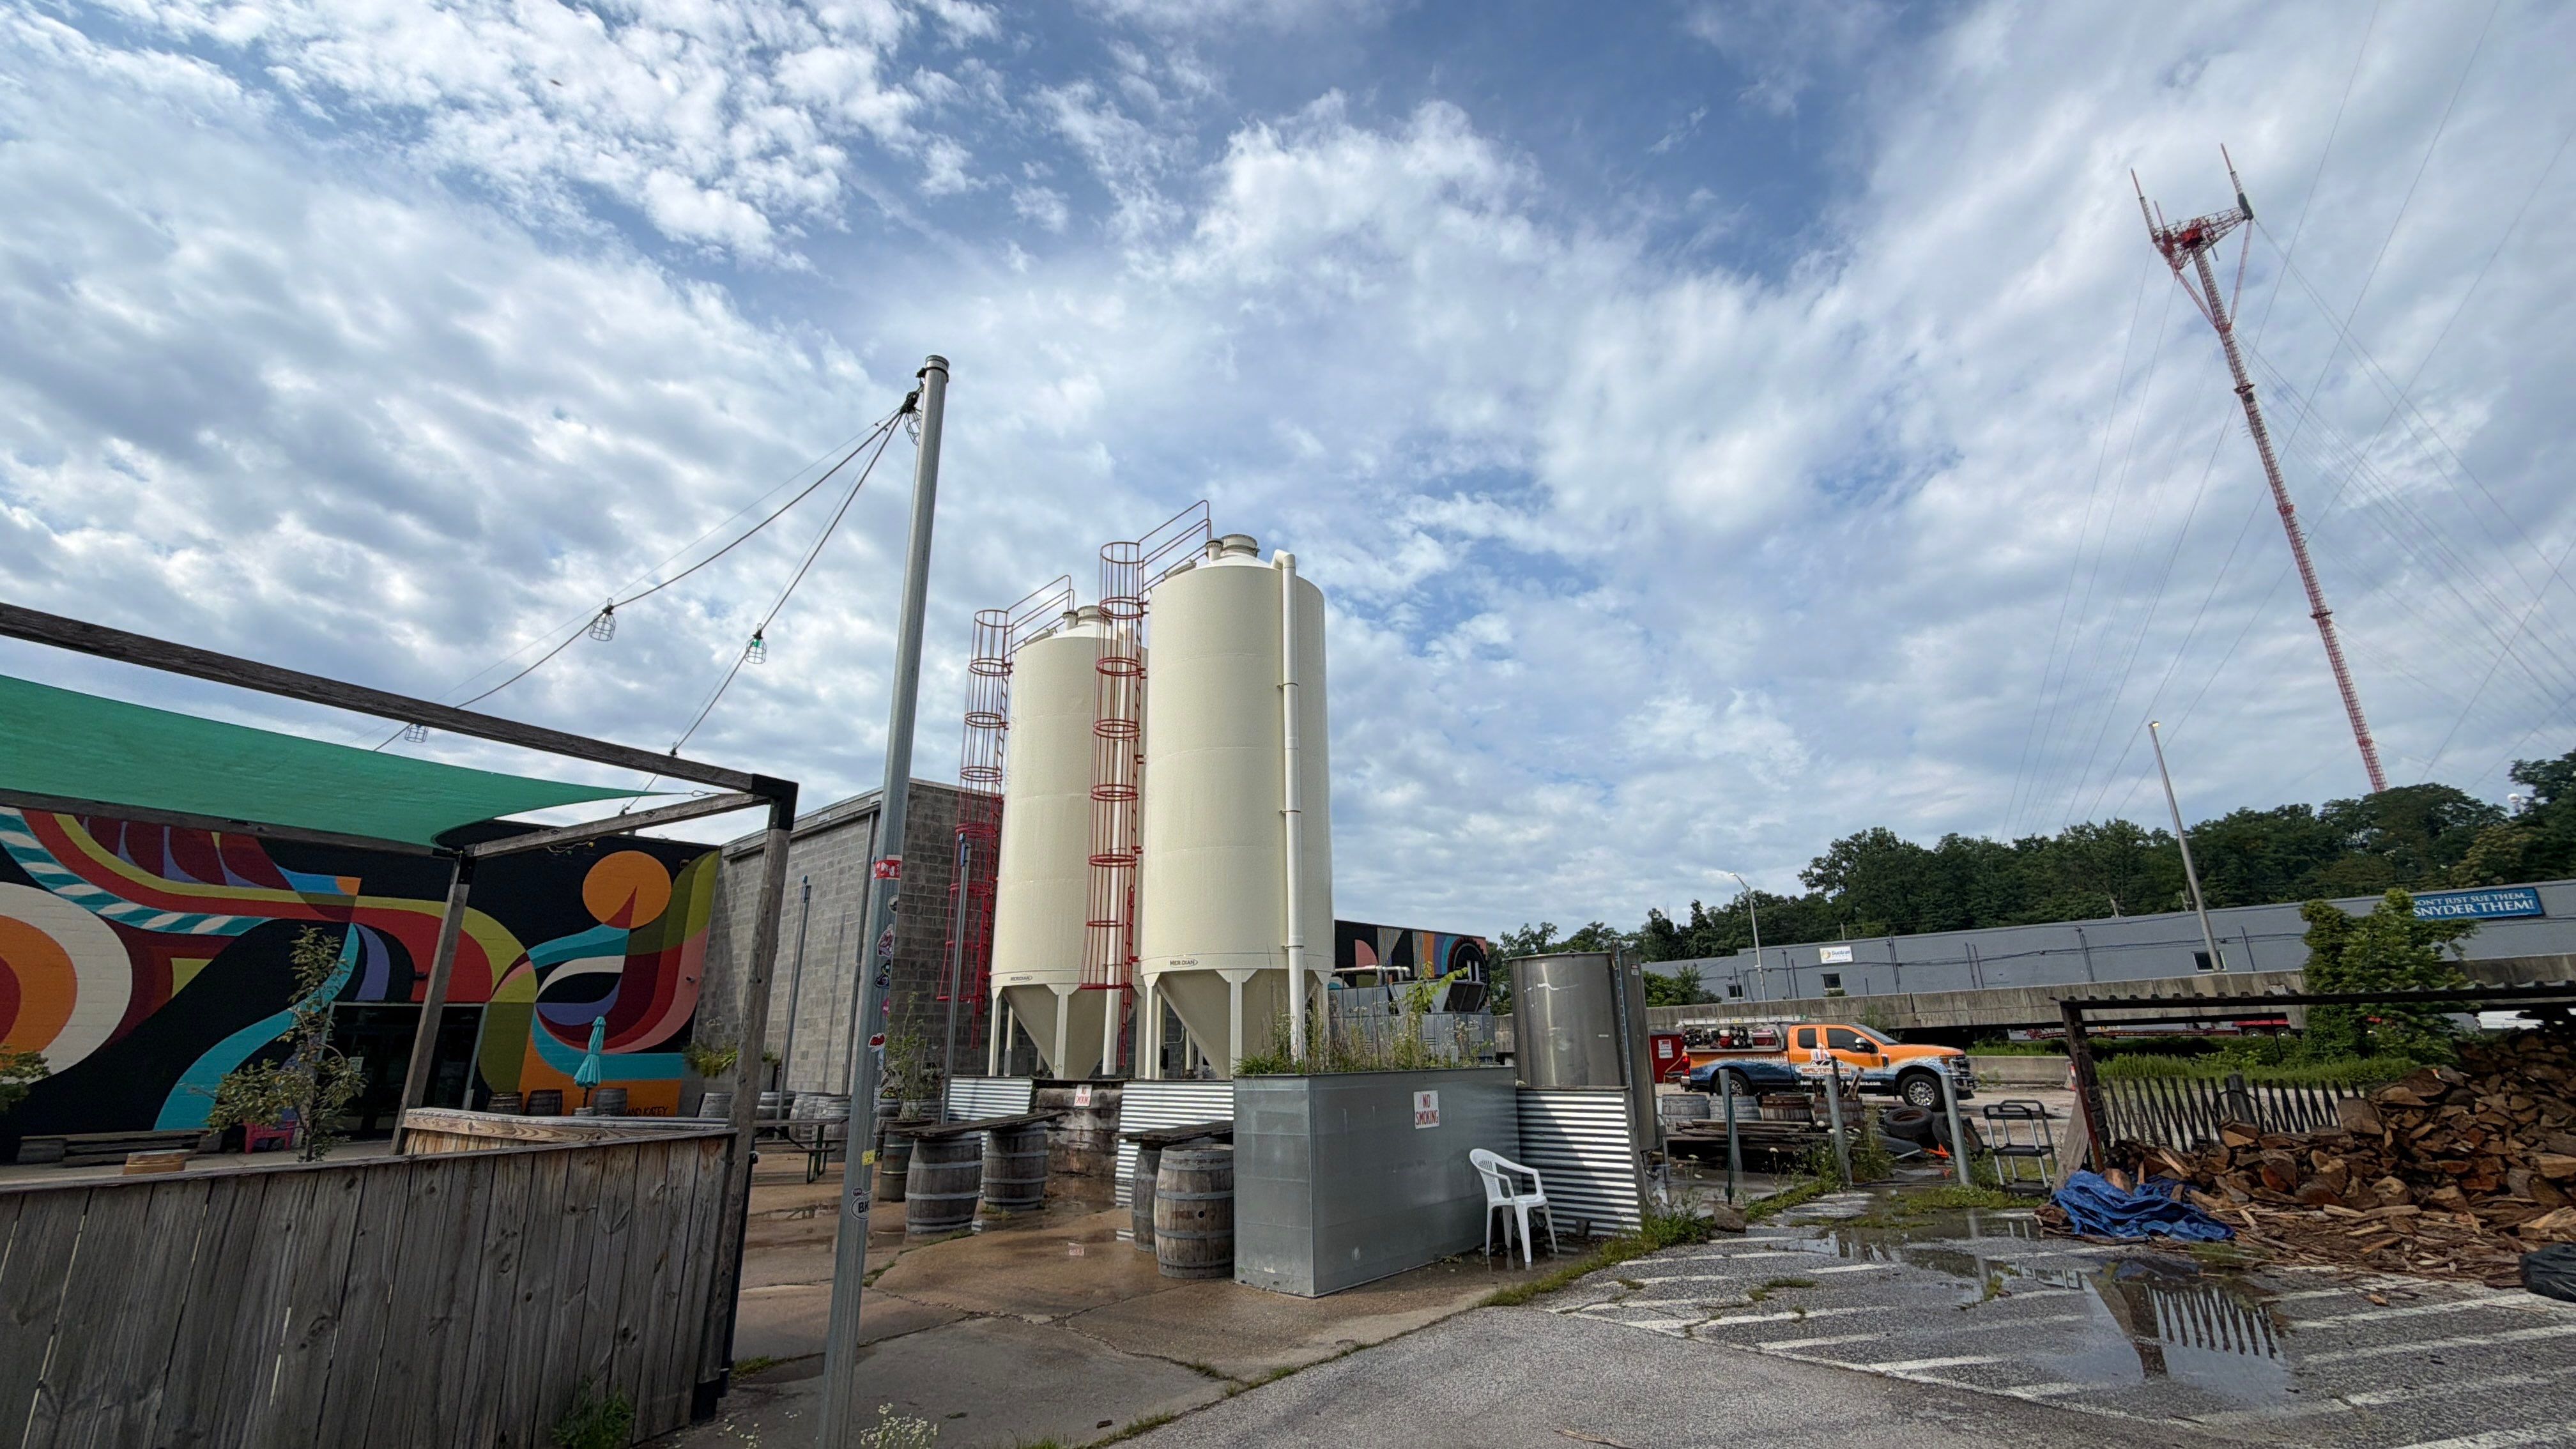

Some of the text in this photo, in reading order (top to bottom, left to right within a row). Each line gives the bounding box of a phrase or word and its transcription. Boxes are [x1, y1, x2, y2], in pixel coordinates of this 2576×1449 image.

[2412, 899, 2536, 917] SNYDER THEM!
[2444, 896, 2467, 905] JUST
[1422, 1093, 1430, 1108] NO
[1415, 1109, 1439, 1126] SMOKING
